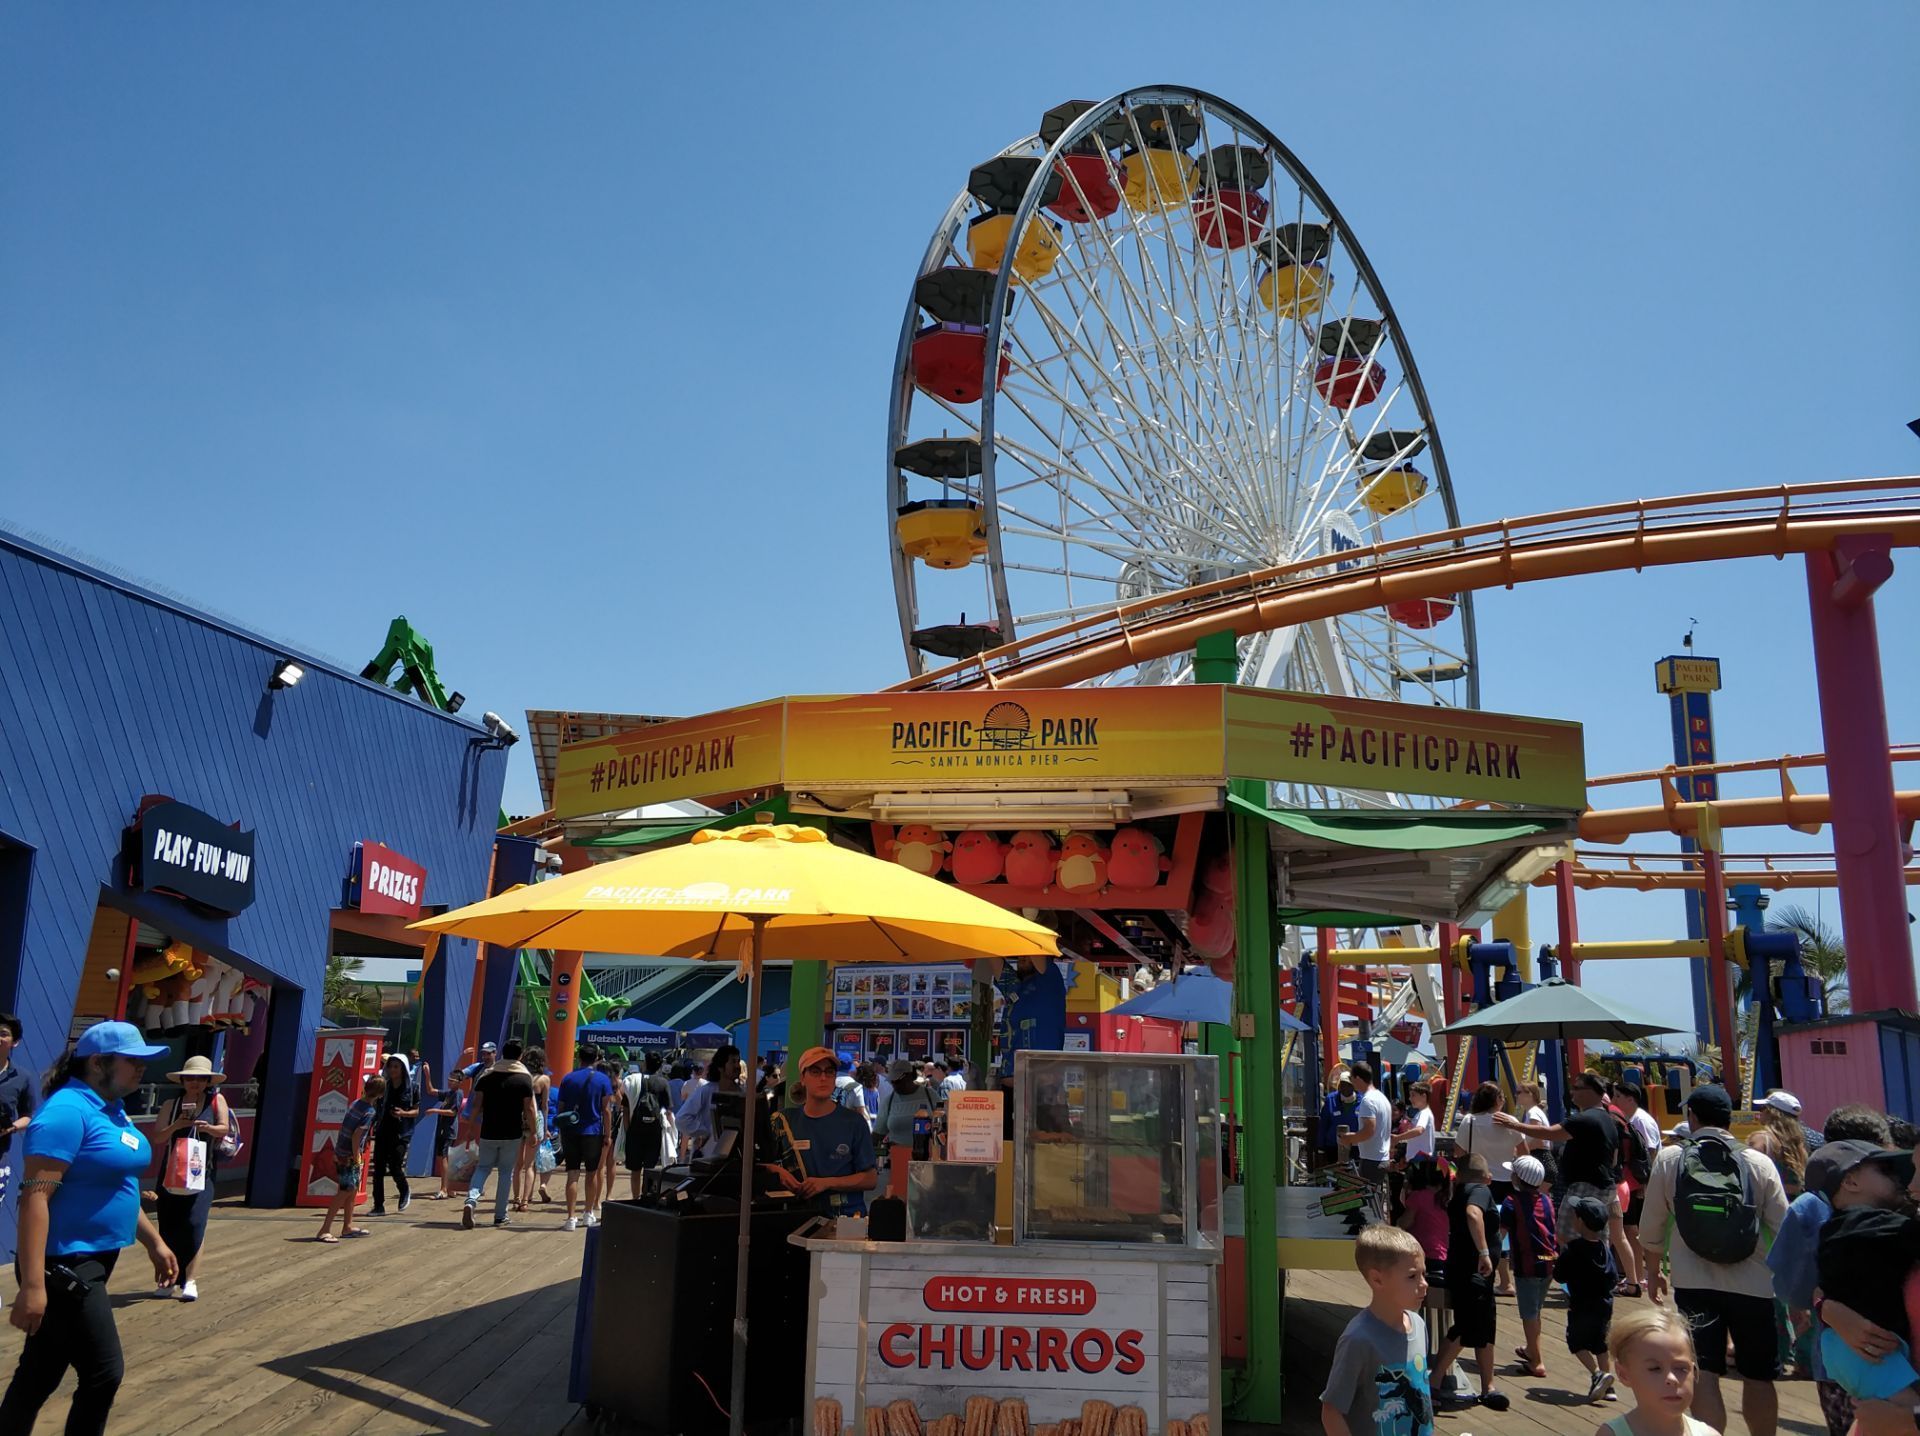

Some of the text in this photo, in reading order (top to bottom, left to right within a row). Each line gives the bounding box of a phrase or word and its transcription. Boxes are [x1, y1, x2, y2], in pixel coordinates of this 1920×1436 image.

[1675, 662, 1714, 674] PACIFIC
[1683, 673, 1710, 683] PARK
[891, 717, 1099, 749] PACIFIC PARK
[1289, 721, 1521, 780] #PACIFICPARK
[590, 735, 735, 793] #PACIFICPARK
[930, 754, 1059, 768] SANTA MONICA PIER
[368, 860, 419, 905] PRIZES
[584, 886, 793, 900] PACIFIC PARK
[587, 1033, 668, 1045] Wetzel's Pretzels
[843, 1033, 860, 1043] OPEN
[876, 1036, 892, 1045] OPEN
[956, 1103, 996, 1111] CHURROS
[940, 1285, 1086, 1305] HOT & FRESH
[877, 1322, 1146, 1375] CHURROS
